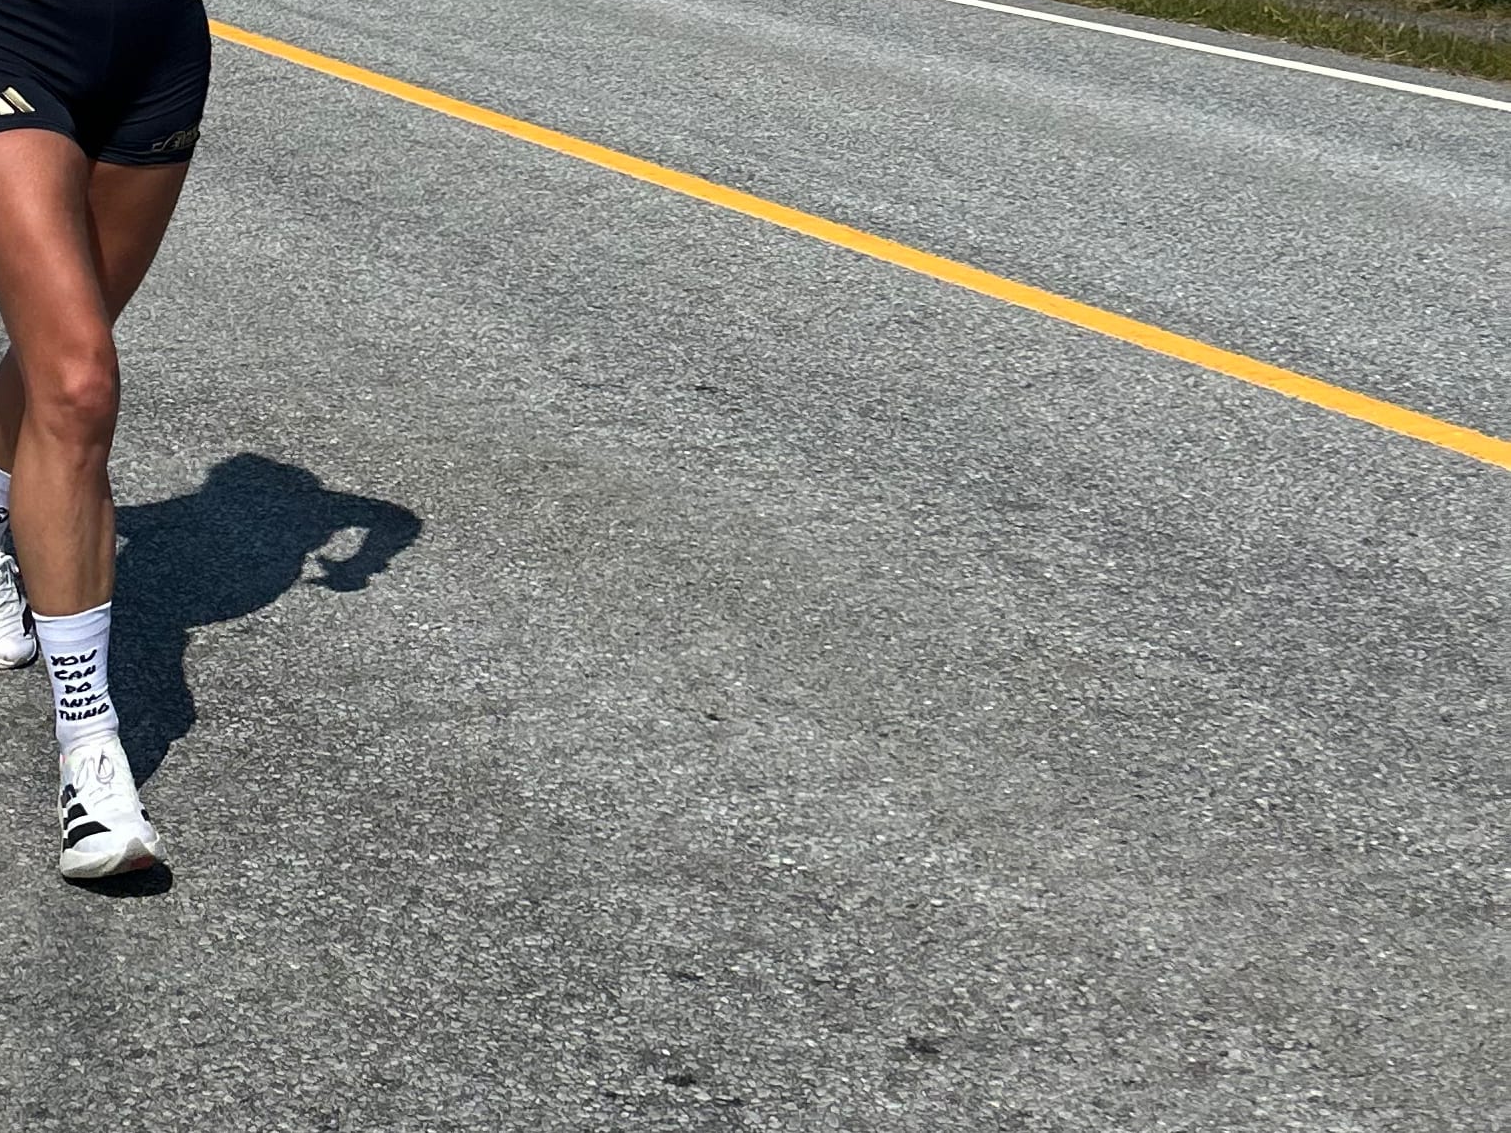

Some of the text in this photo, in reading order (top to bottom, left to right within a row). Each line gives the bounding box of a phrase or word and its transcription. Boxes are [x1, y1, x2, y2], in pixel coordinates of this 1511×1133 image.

[50, 649, 97, 666] YOU
[54, 665, 96, 680] CAN
[64, 681, 92, 694] DO
